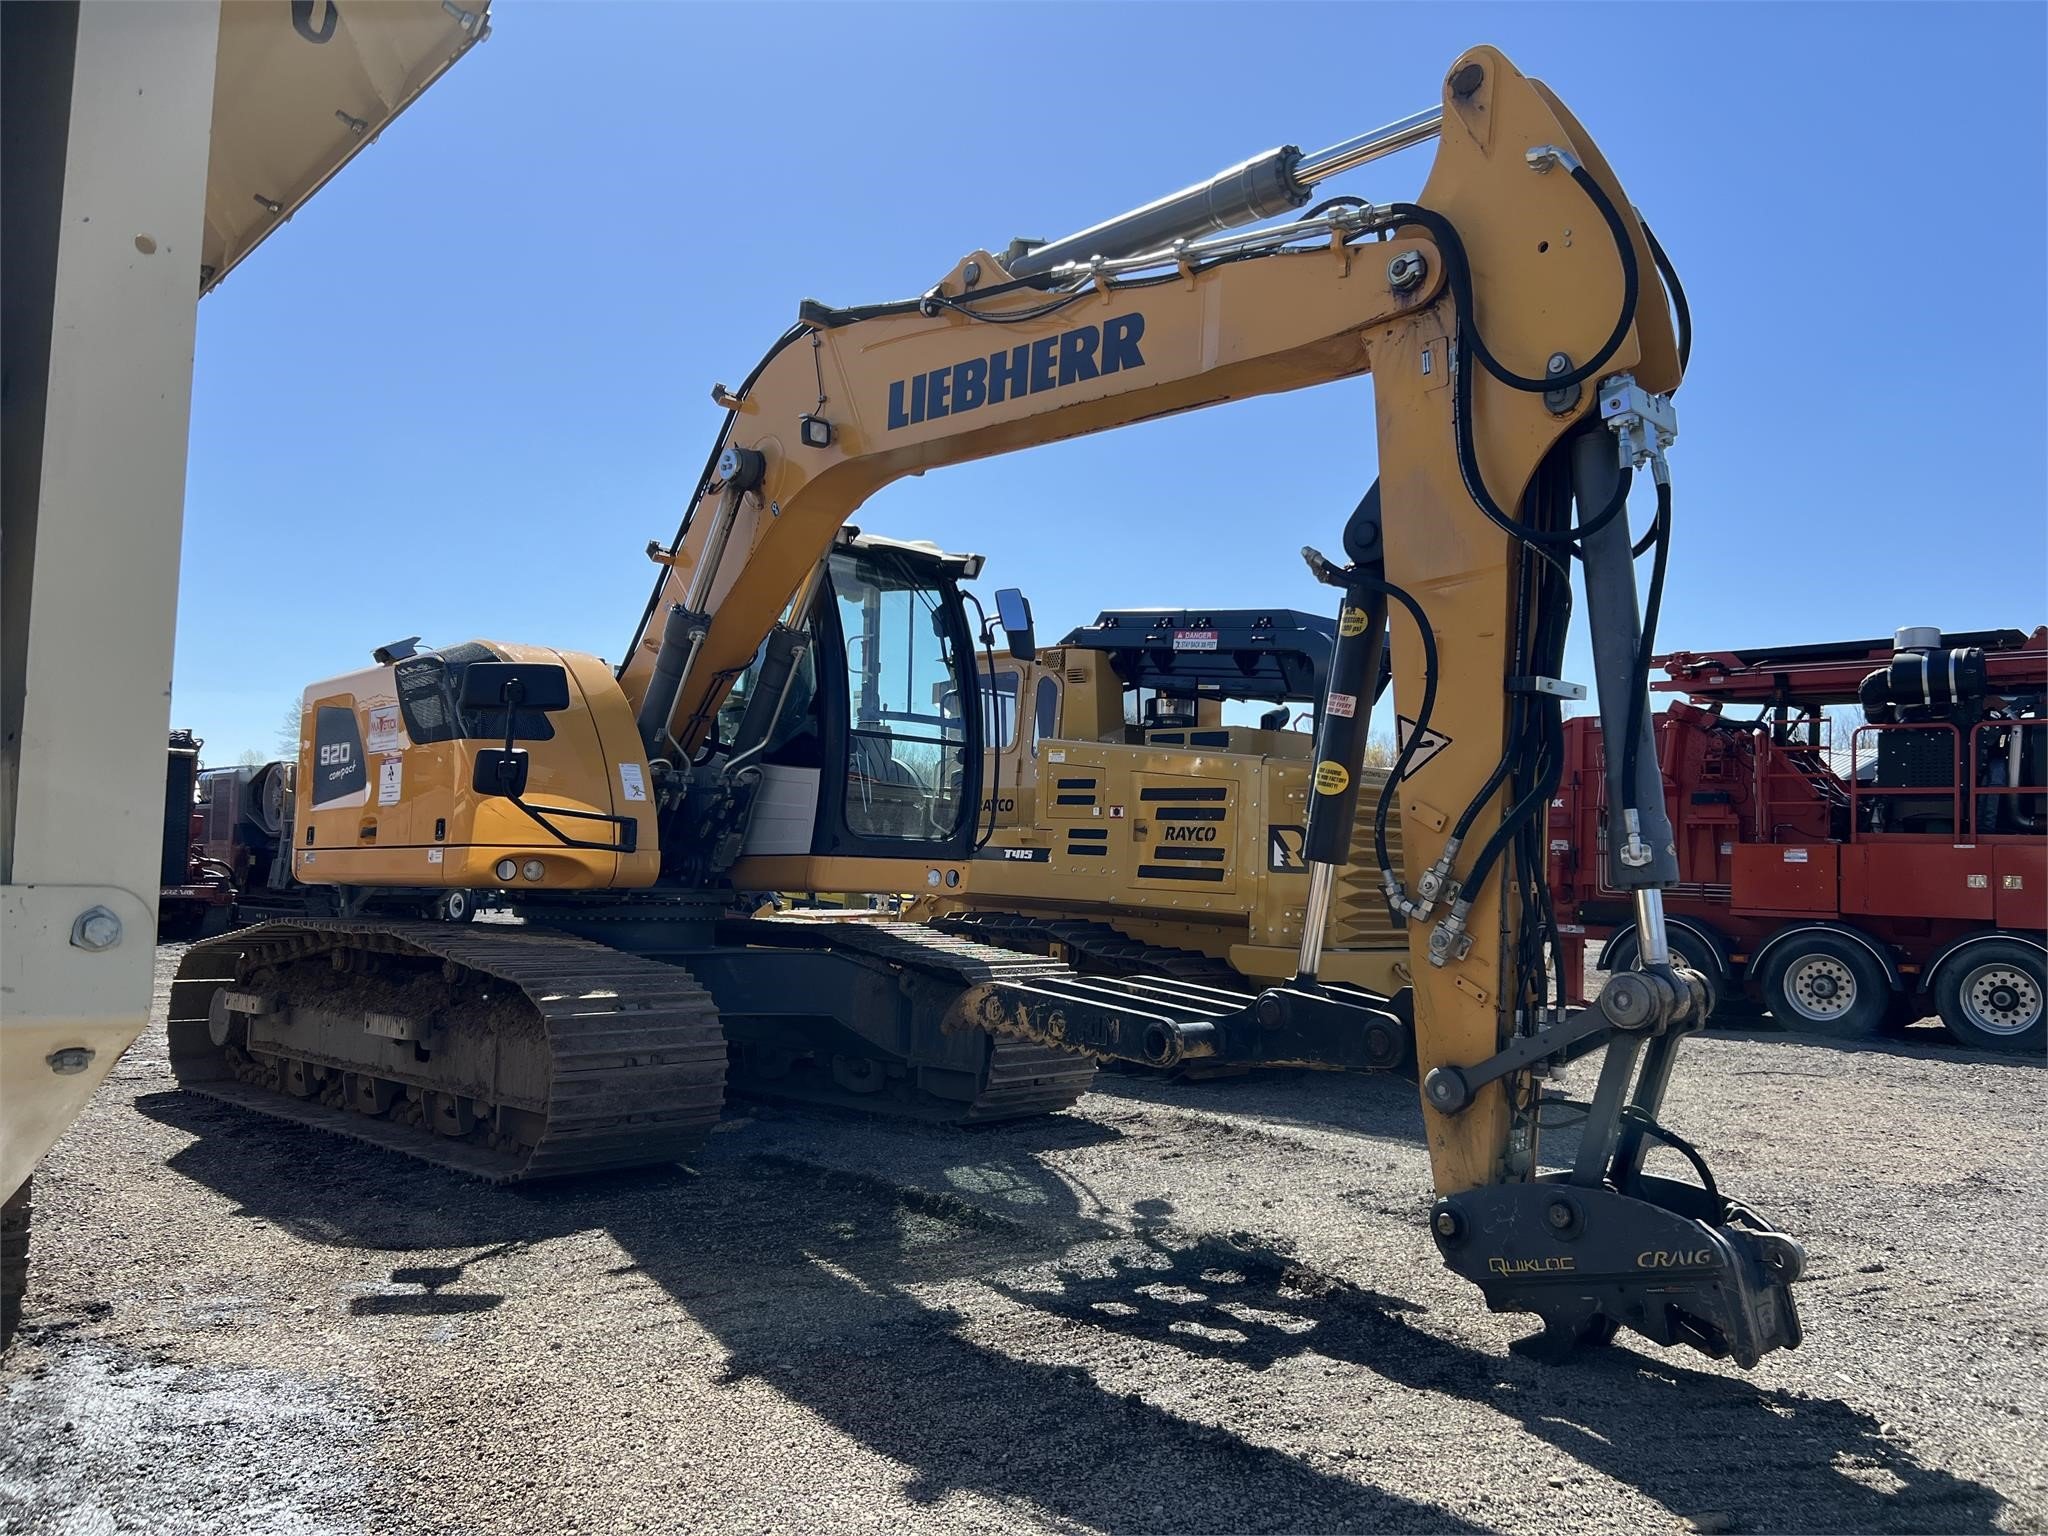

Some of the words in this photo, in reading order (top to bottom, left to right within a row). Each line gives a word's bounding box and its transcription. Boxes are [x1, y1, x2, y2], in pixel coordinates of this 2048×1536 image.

[887, 311, 1146, 431] LIEBHERR
[1185, 631, 1212, 639] DANGER
[321, 742, 351, 766] 920
[329, 760, 356, 781] compact
[1165, 826, 1217, 842] RAYCO
[1004, 849, 1033, 859] T415
[1488, 1257, 1576, 1277] QUIKLOC
[1637, 1250, 1711, 1268] CRAIG
